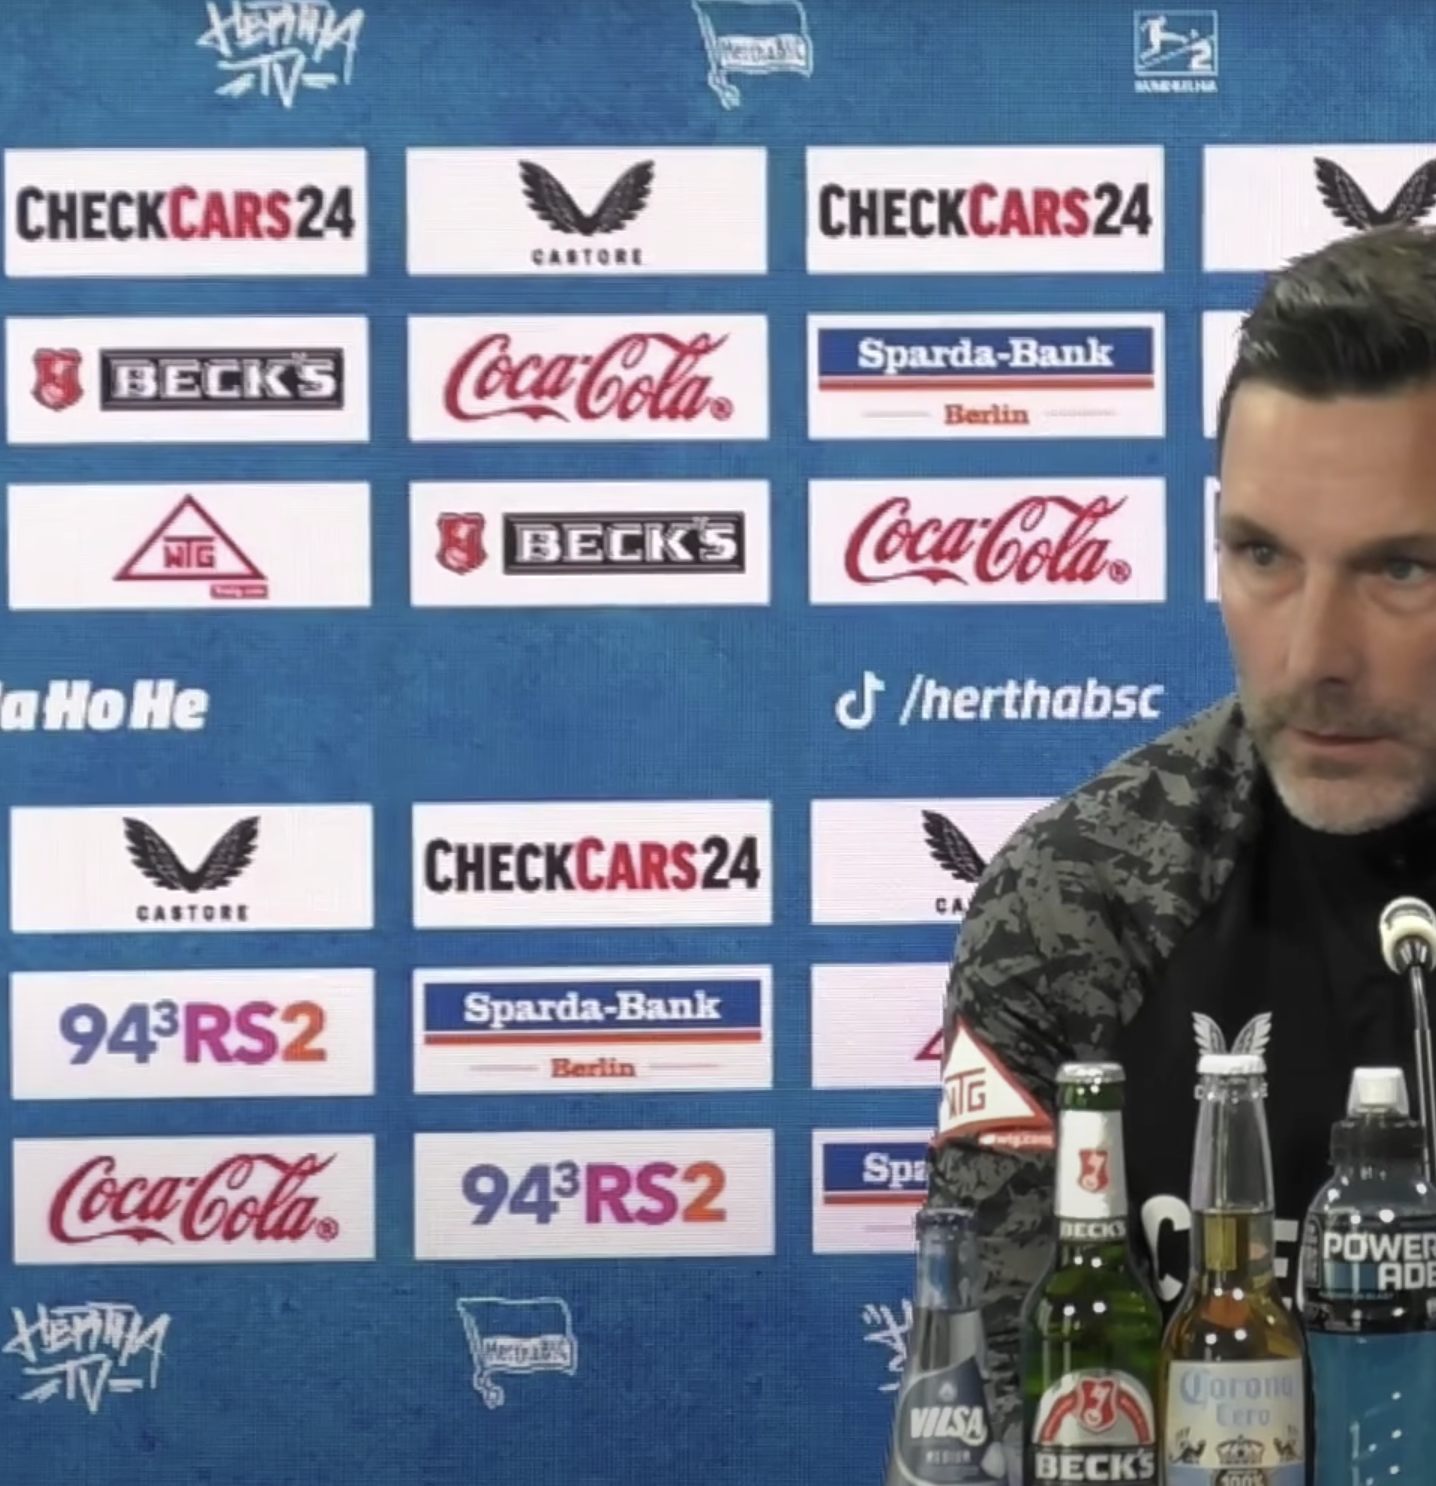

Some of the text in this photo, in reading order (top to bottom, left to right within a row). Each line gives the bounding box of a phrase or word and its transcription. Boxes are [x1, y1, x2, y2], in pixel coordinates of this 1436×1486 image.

[17, 186, 355, 241] CHECKCARS24
[820, 183, 1152, 238] CHECKCARS24
[533, 249, 641, 265] CASTORE
[858, 335, 1115, 373] Sparda-Bank
[112, 353, 337, 399] BECK'S
[945, 404, 1029, 425] Berlin
[516, 516, 738, 562] BECK'S
[0, 681, 39, 731] a
[900, 674, 1164, 725] /herthabsc
[425, 836, 760, 893] CHECKCARS24
[137, 905, 246, 921] CASTORE
[464, 991, 722, 1029] Sparda-Bank
[551, 1058, 636, 1078] Berlin
[1180, 1367, 1293, 1410] Corona
[911, 1405, 988, 1447] VILSA
[1035, 1448, 1154, 1481] BECK'S
